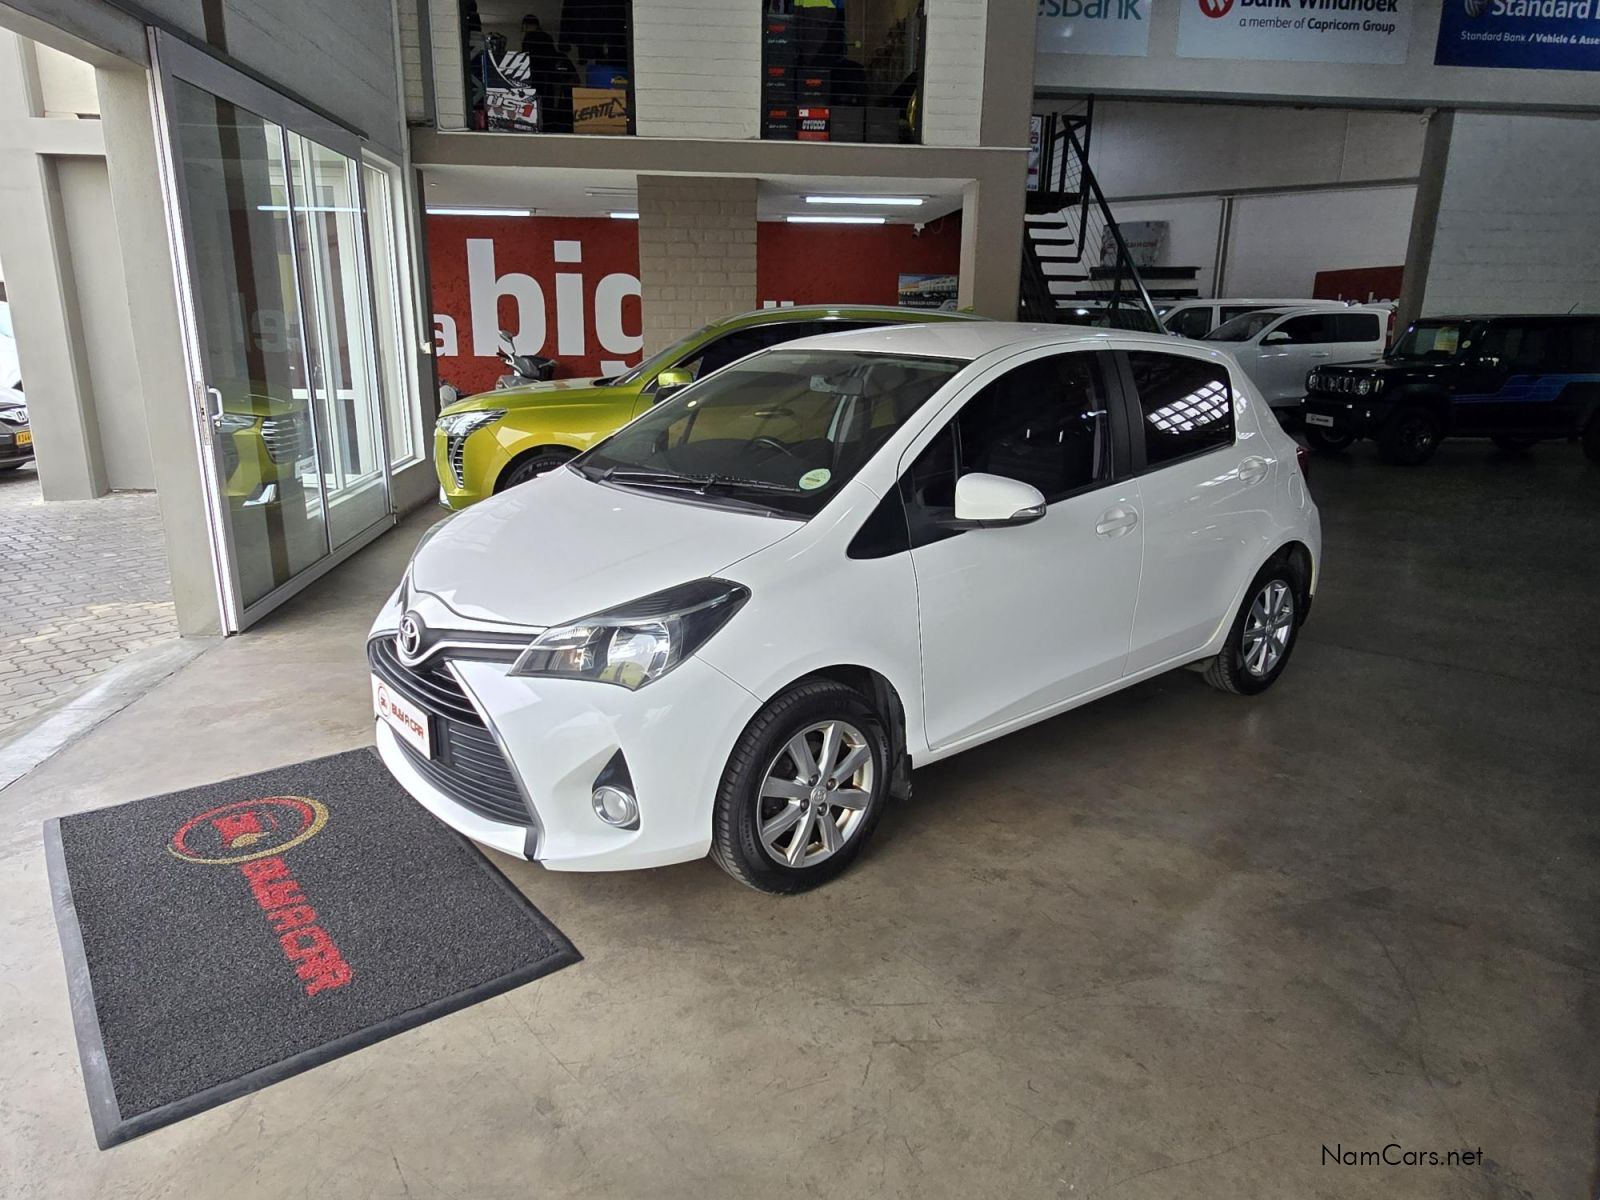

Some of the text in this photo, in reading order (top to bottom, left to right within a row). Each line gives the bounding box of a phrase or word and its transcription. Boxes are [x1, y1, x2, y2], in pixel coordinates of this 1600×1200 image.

[1491, 0, 1590, 19] Standard
[1239, 16, 1396, 35] a member of Capricorn Group
[1460, 30, 1502, 41] Standard
[1503, 32, 1526, 42] Bank
[1535, 33, 1568, 44] Vehicle
[1569, 34, 1577, 44] &
[433, 238, 645, 378] a big
[391, 702, 424, 739] BUY A CAR
[240, 857, 353, 997] BUY A CAR
